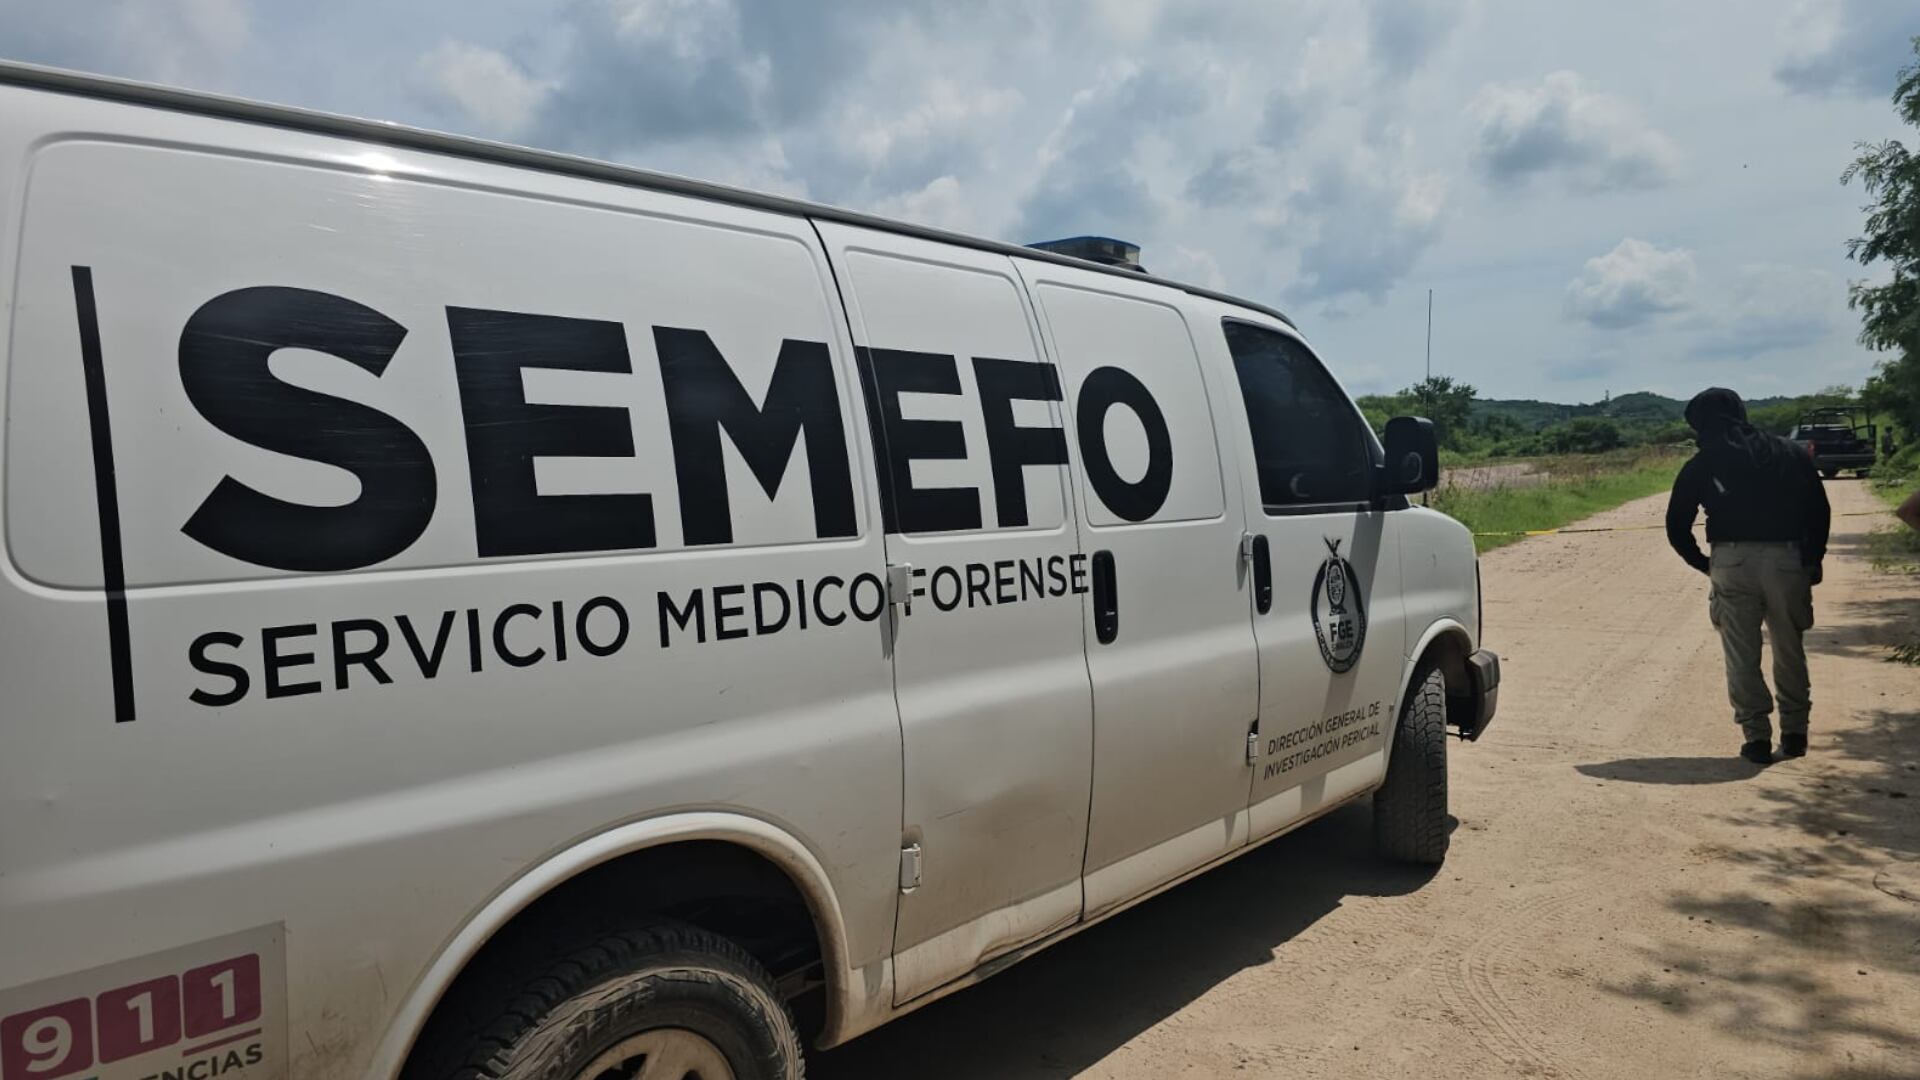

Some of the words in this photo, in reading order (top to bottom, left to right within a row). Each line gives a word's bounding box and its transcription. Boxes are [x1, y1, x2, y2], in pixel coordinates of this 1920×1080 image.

[178, 286, 1172, 571] SEMEFO
[189, 596, 629, 707] SERVICIO
[657, 573, 885, 648] MEDICO
[1329, 620, 1354, 642] FGE
[1264, 737, 1340, 780] INVESTIGACIÓN
[1341, 722, 1380, 748] PERICIAL
[1268, 721, 1323, 755] DIRECCIÓN
[1325, 708, 1366, 733] GENERAL
[1368, 701, 1380, 717] DE
[22, 969, 235, 1072] 911
